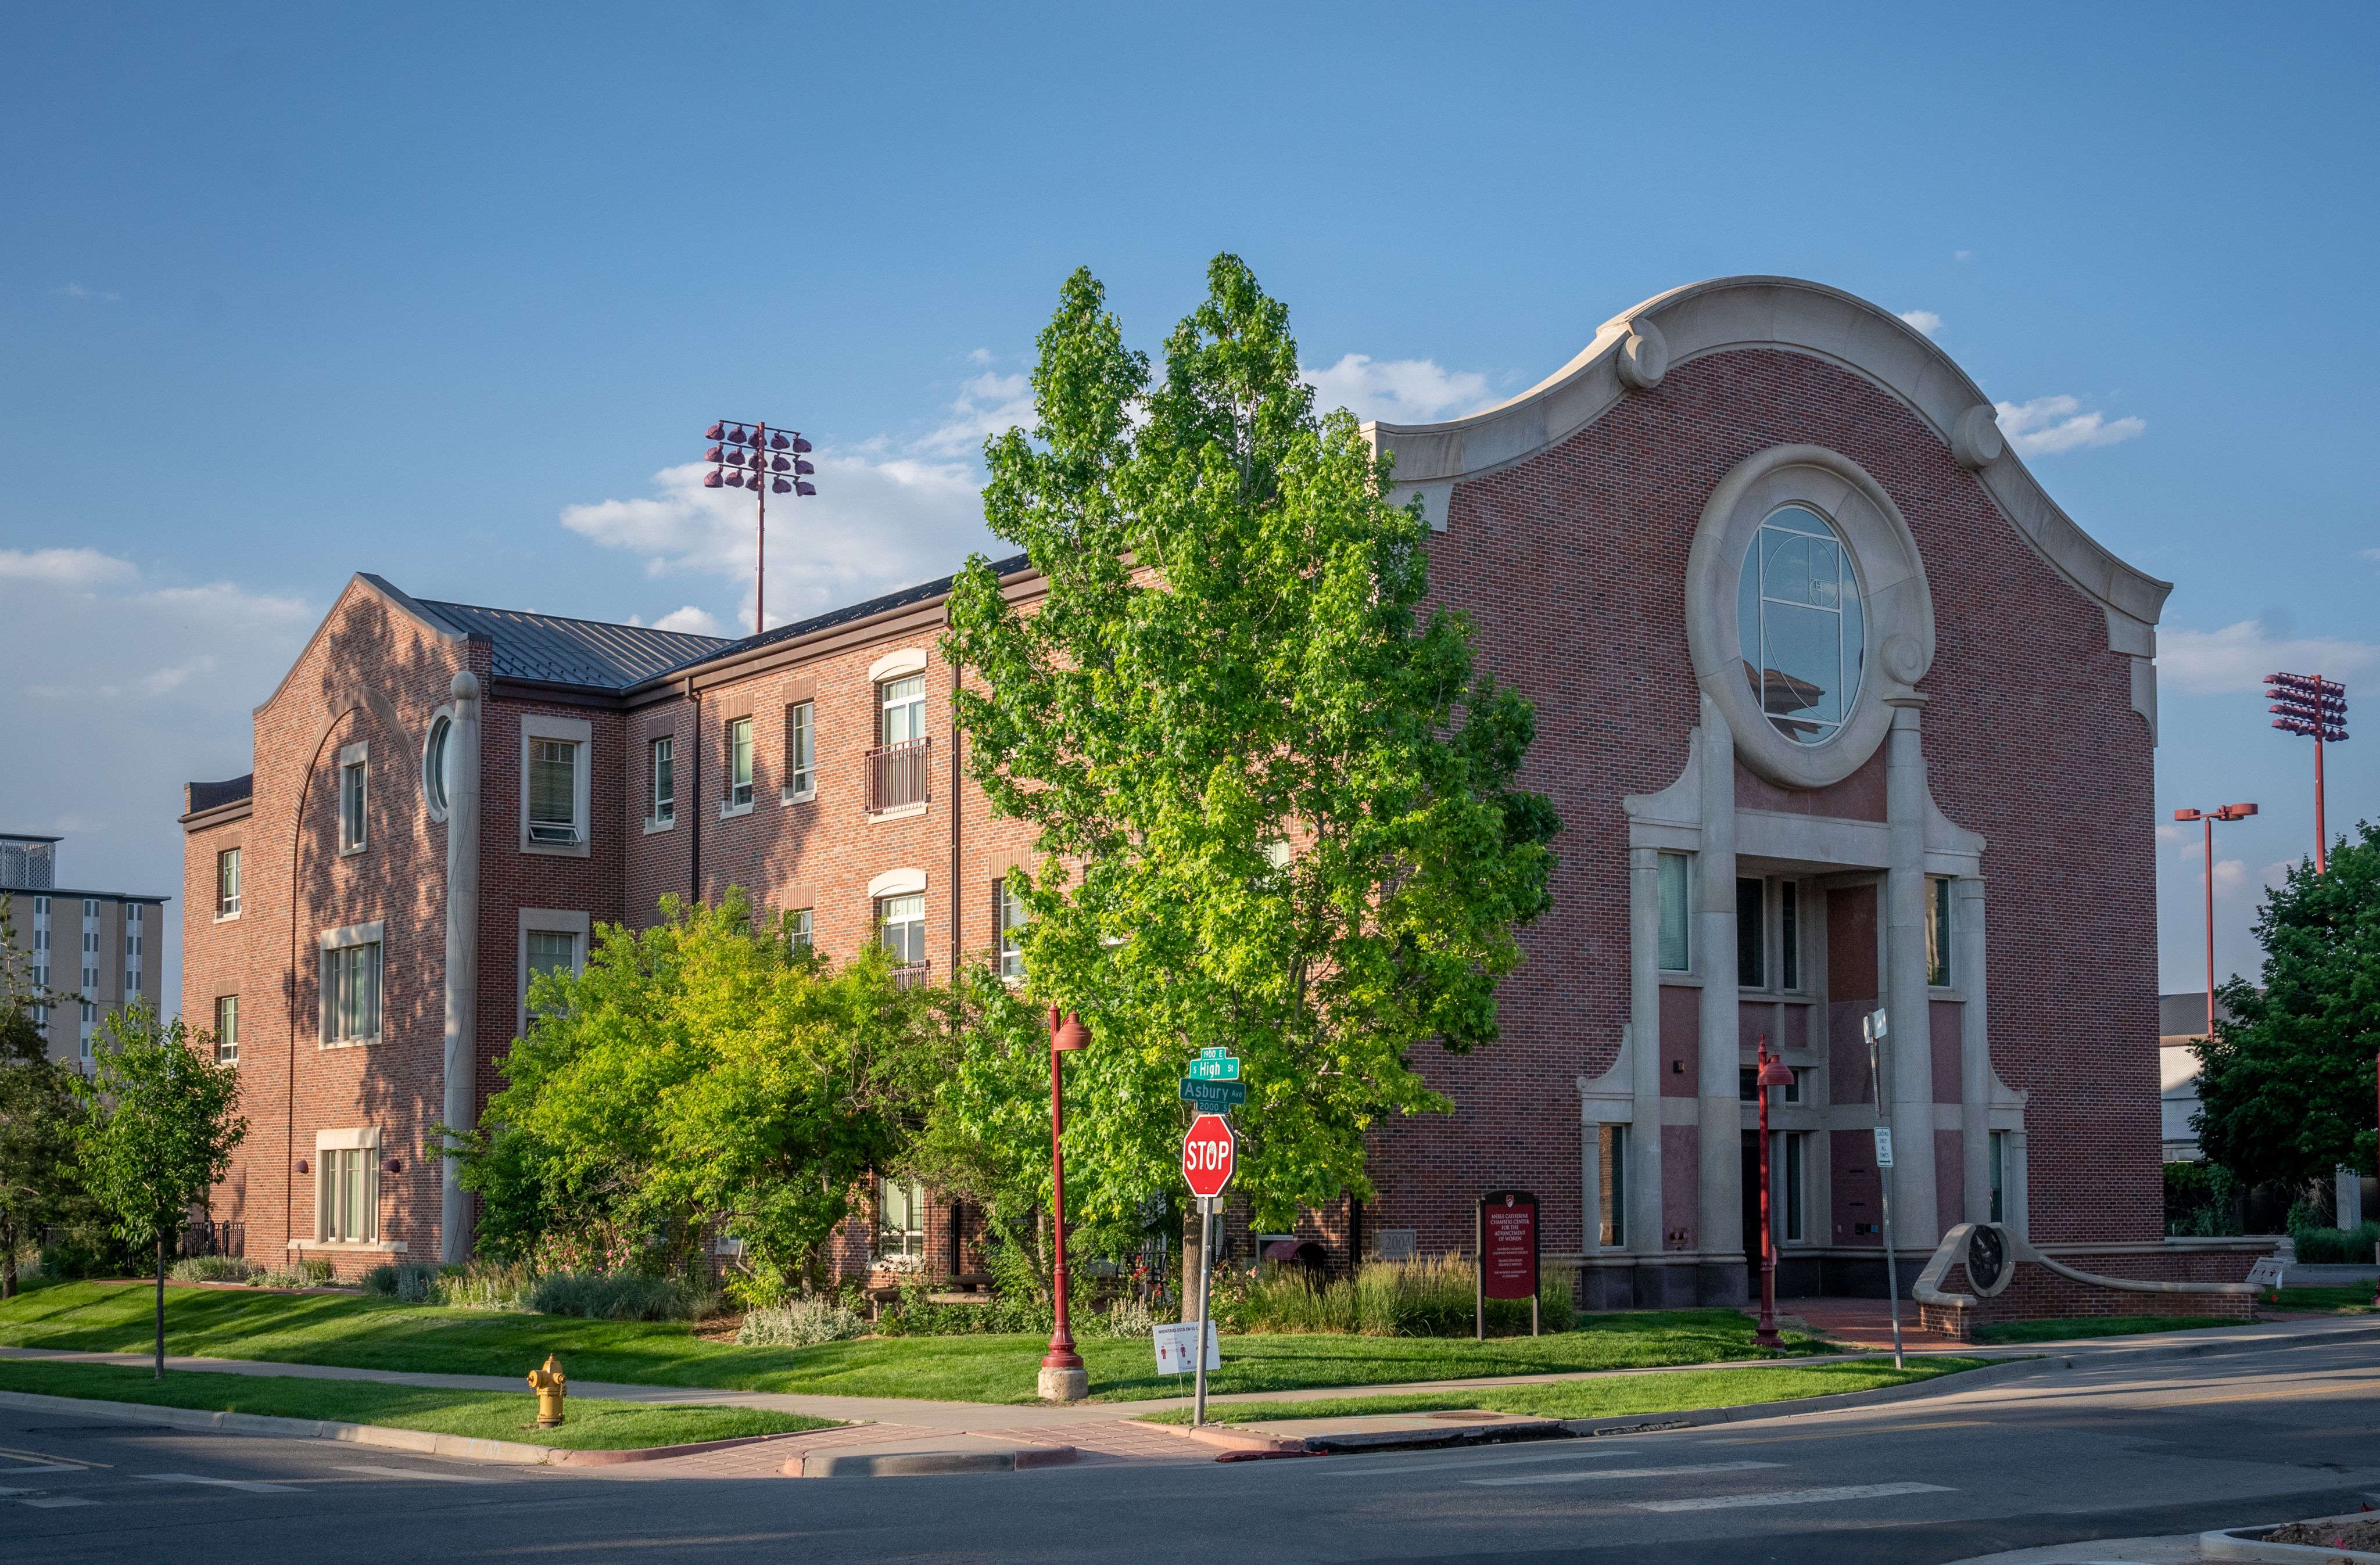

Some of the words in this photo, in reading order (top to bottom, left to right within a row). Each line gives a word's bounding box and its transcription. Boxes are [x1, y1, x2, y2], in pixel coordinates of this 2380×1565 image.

[1203, 1050, 1216, 1058] 1900
[1200, 1061, 1220, 1078] High
[1228, 1064, 1234, 1072] St
[1184, 1082, 1228, 1101] Asbury
[1231, 1089, 1242, 1097] Ave
[1199, 1102, 1218, 1111] 2000
[1187, 1140, 1229, 1171] STOP
[1385, 1236, 1410, 1250] 2004
